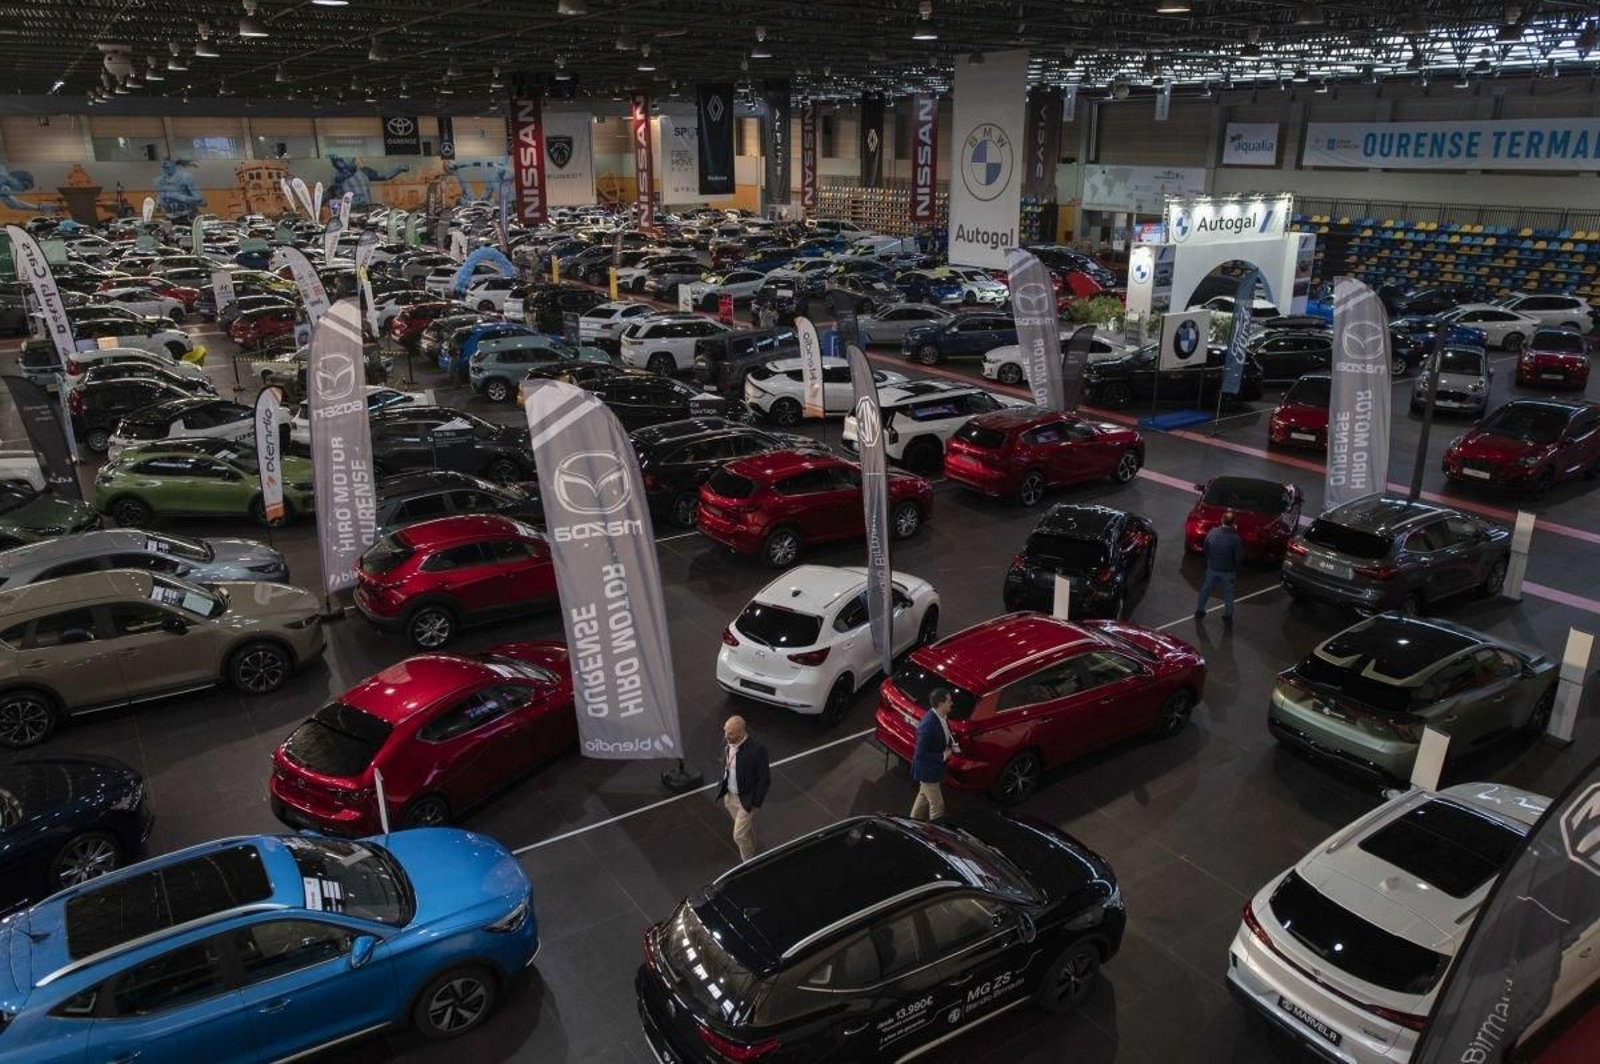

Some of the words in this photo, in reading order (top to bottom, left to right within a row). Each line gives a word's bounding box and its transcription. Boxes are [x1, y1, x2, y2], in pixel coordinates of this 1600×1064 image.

[518, 100, 541, 219] NISSAN
[632, 96, 651, 228] NISSAN
[803, 106, 813, 205] NISSAN
[916, 99, 934, 217] NISSAN
[1234, 140, 1274, 153] aqualia
[1363, 131, 1482, 158] OURENSE
[1492, 130, 1600, 159] TERMA
[955, 224, 1014, 249] Autogal
[1197, 213, 1257, 234] Autogal
[313, 400, 364, 422] mazda
[331, 436, 350, 500] MOTOR
[352, 458, 377, 546] OURENSE
[335, 503, 355, 552] HIRO
[966, 981, 991, 1003] MG
[992, 971, 1012, 991] ZS
[1292, 1006, 1329, 1038] MARVEL
[1328, 1030, 1338, 1042] R
